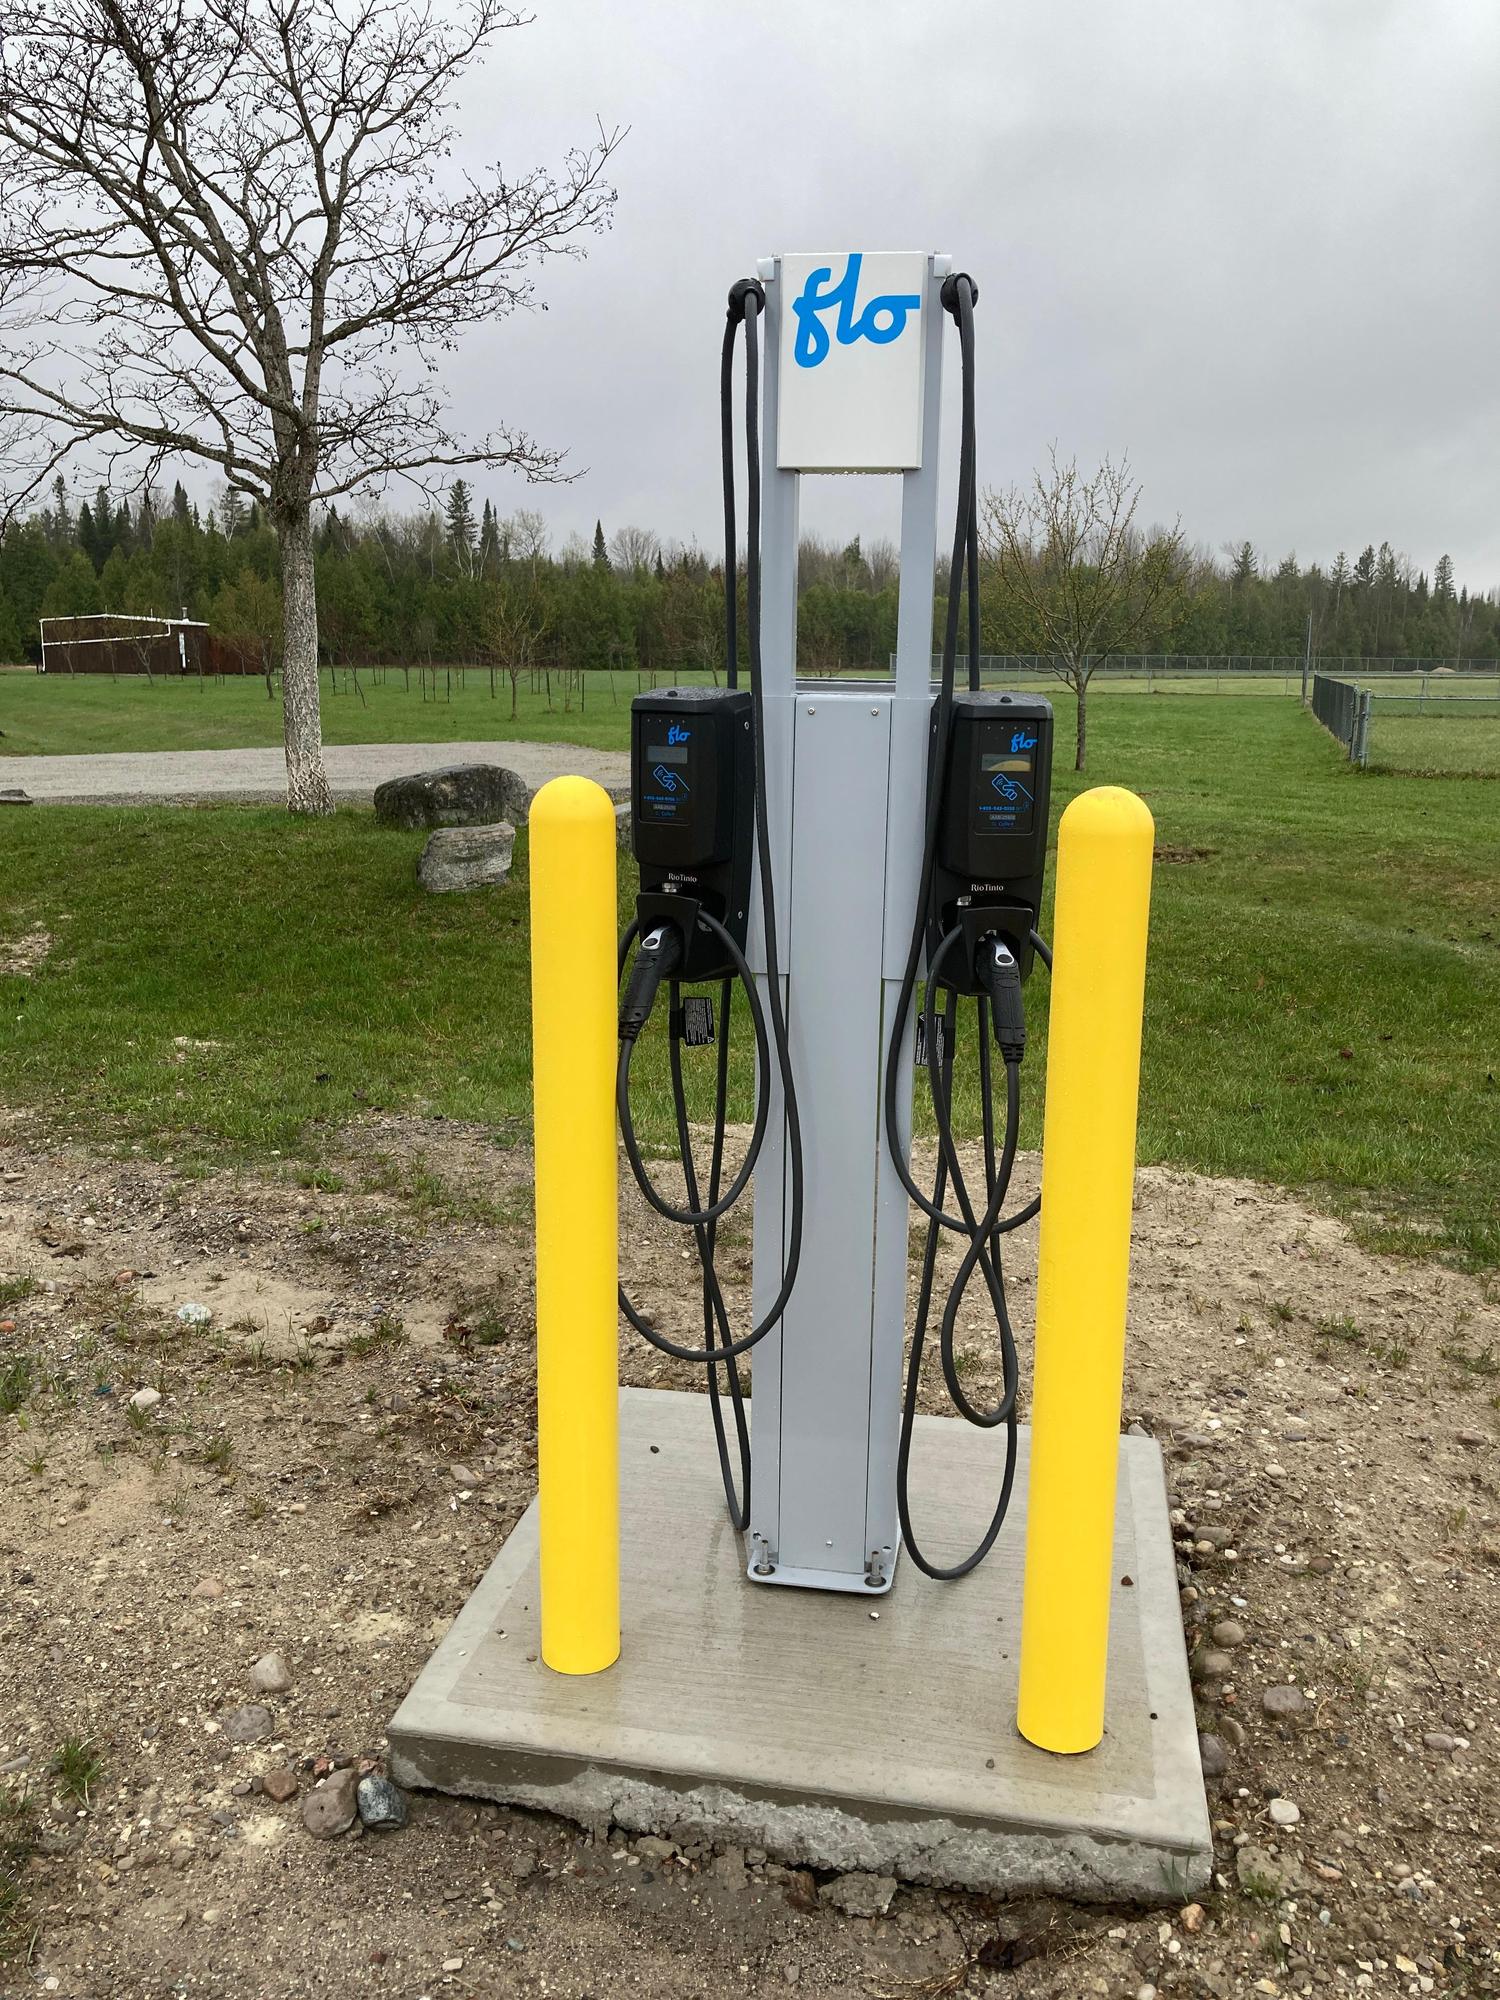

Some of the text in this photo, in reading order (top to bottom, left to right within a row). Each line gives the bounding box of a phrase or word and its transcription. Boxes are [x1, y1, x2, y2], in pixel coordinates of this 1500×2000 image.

[792, 253, 920, 368] flo
[668, 725, 690, 745] flo
[1011, 732, 1037, 752] flo
